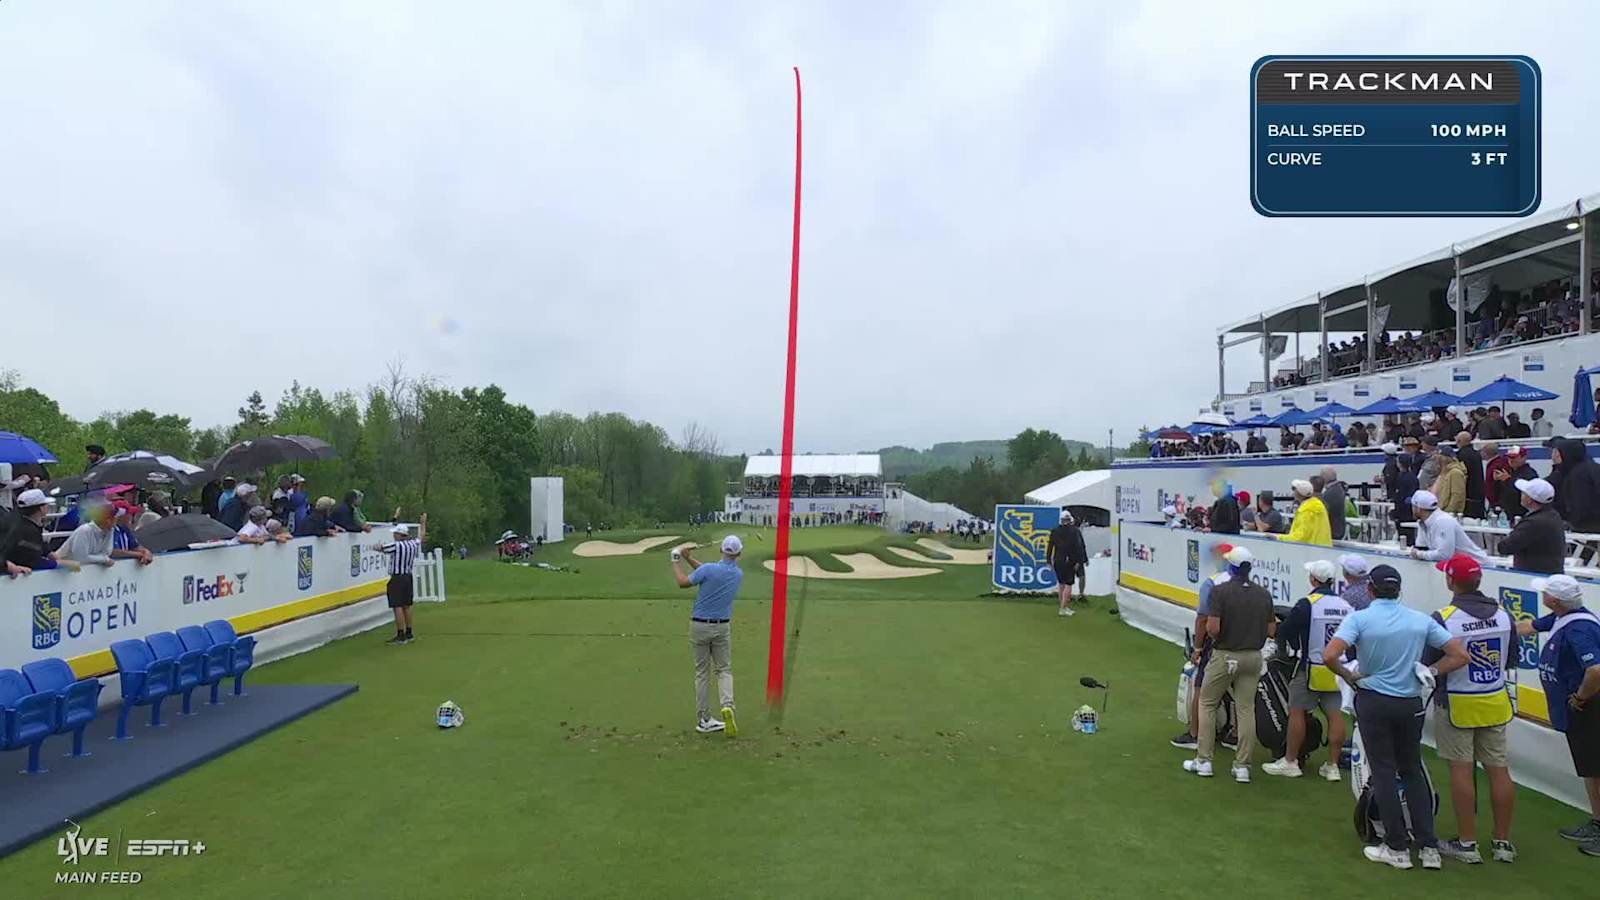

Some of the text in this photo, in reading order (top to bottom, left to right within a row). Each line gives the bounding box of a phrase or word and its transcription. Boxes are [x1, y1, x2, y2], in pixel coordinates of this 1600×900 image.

[1001, 564, 1052, 585] RBC
[68, 578, 138, 605] CANADIAN
[196, 575, 234, 602] FedEx
[67, 601, 138, 638] OPEN
[1462, 618, 1499, 632] SCHENK
[34, 630, 59, 648] RBC
[1519, 646, 1537, 666] BC
[1473, 669, 1499, 682] RBC
